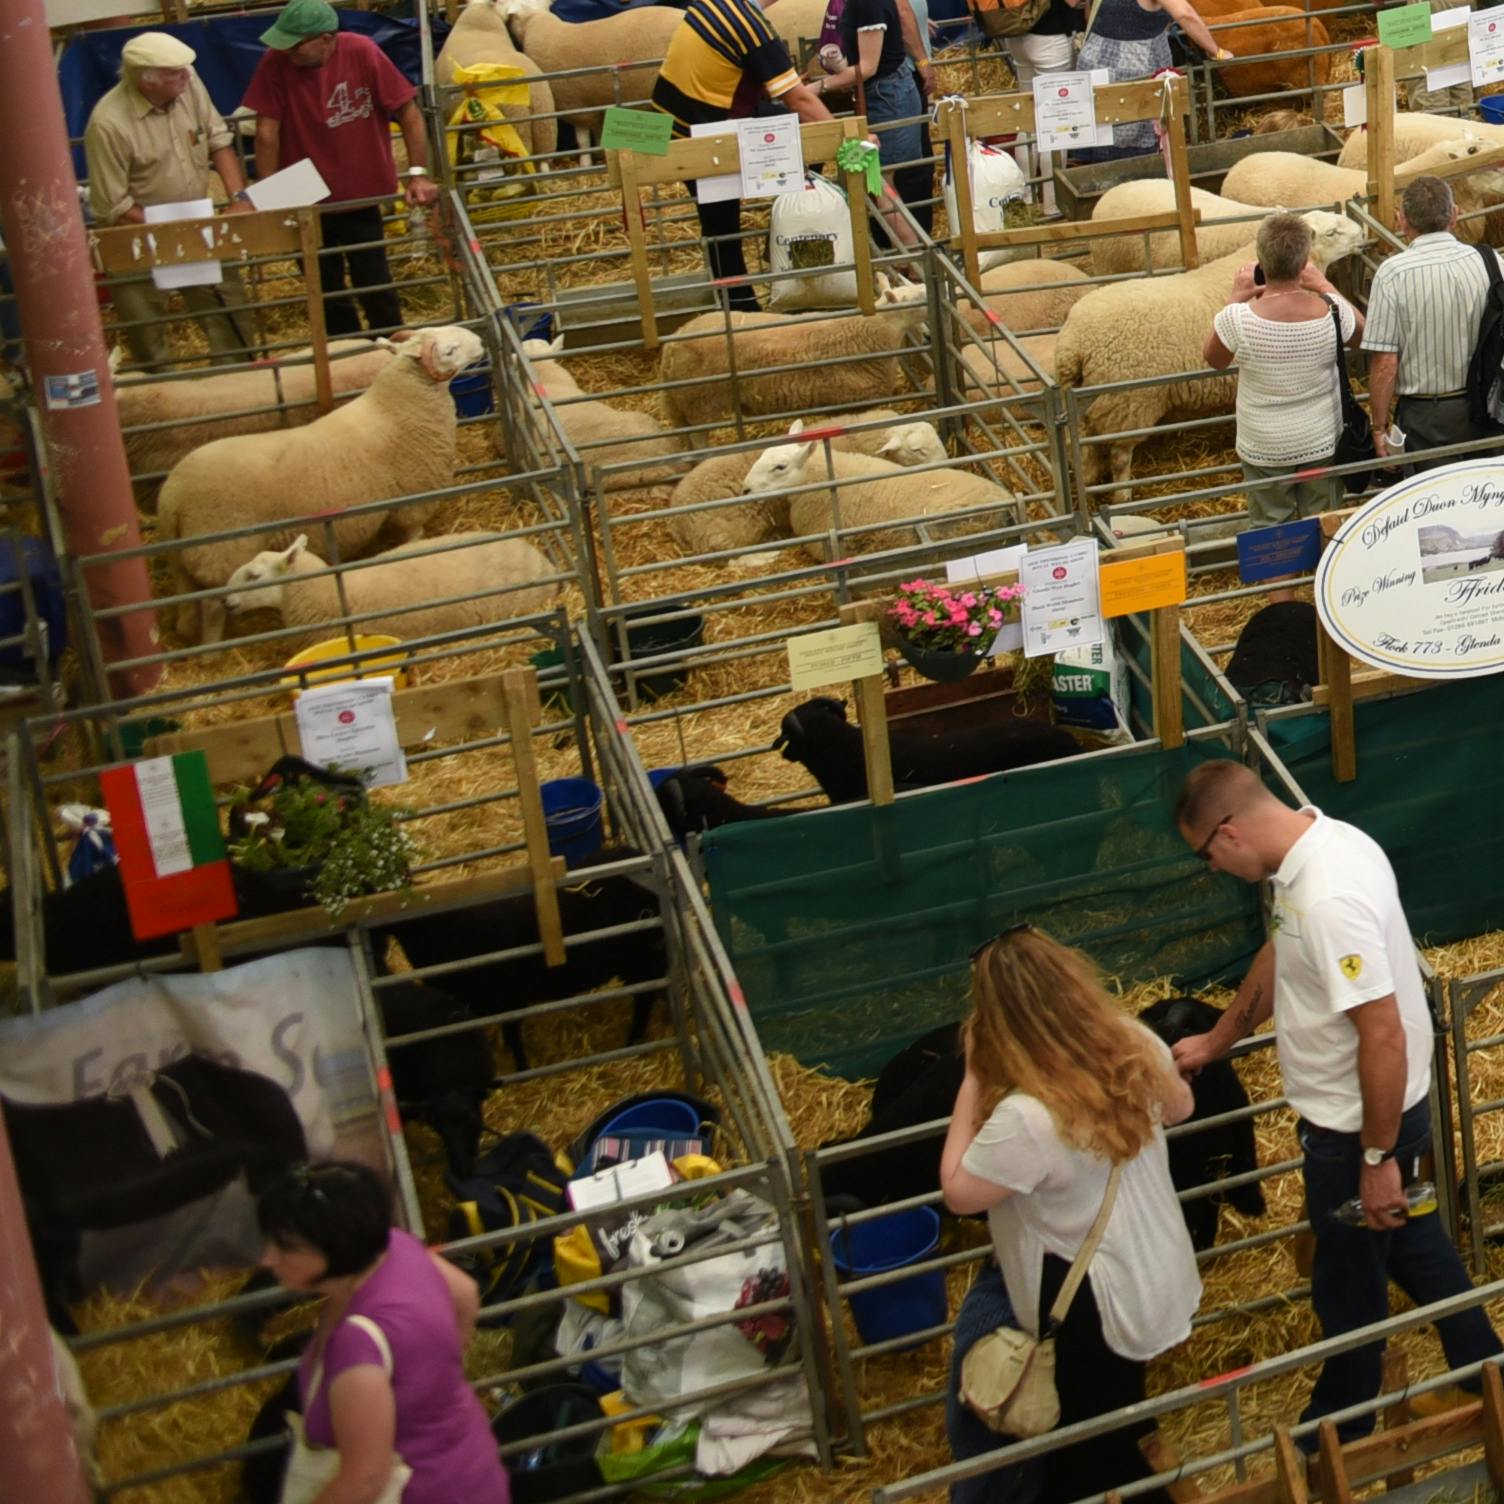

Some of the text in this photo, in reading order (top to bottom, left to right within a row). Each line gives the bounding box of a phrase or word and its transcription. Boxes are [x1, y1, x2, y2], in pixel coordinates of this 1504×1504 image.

[1361, 509, 1410, 550] Defaid
[1412, 494, 1457, 517] Duon
[1341, 569, 1417, 609] Prize Winning
[1371, 632, 1409, 655] Flock
[1412, 640, 1443, 655] 773
[1454, 635, 1501, 656] Glenda
